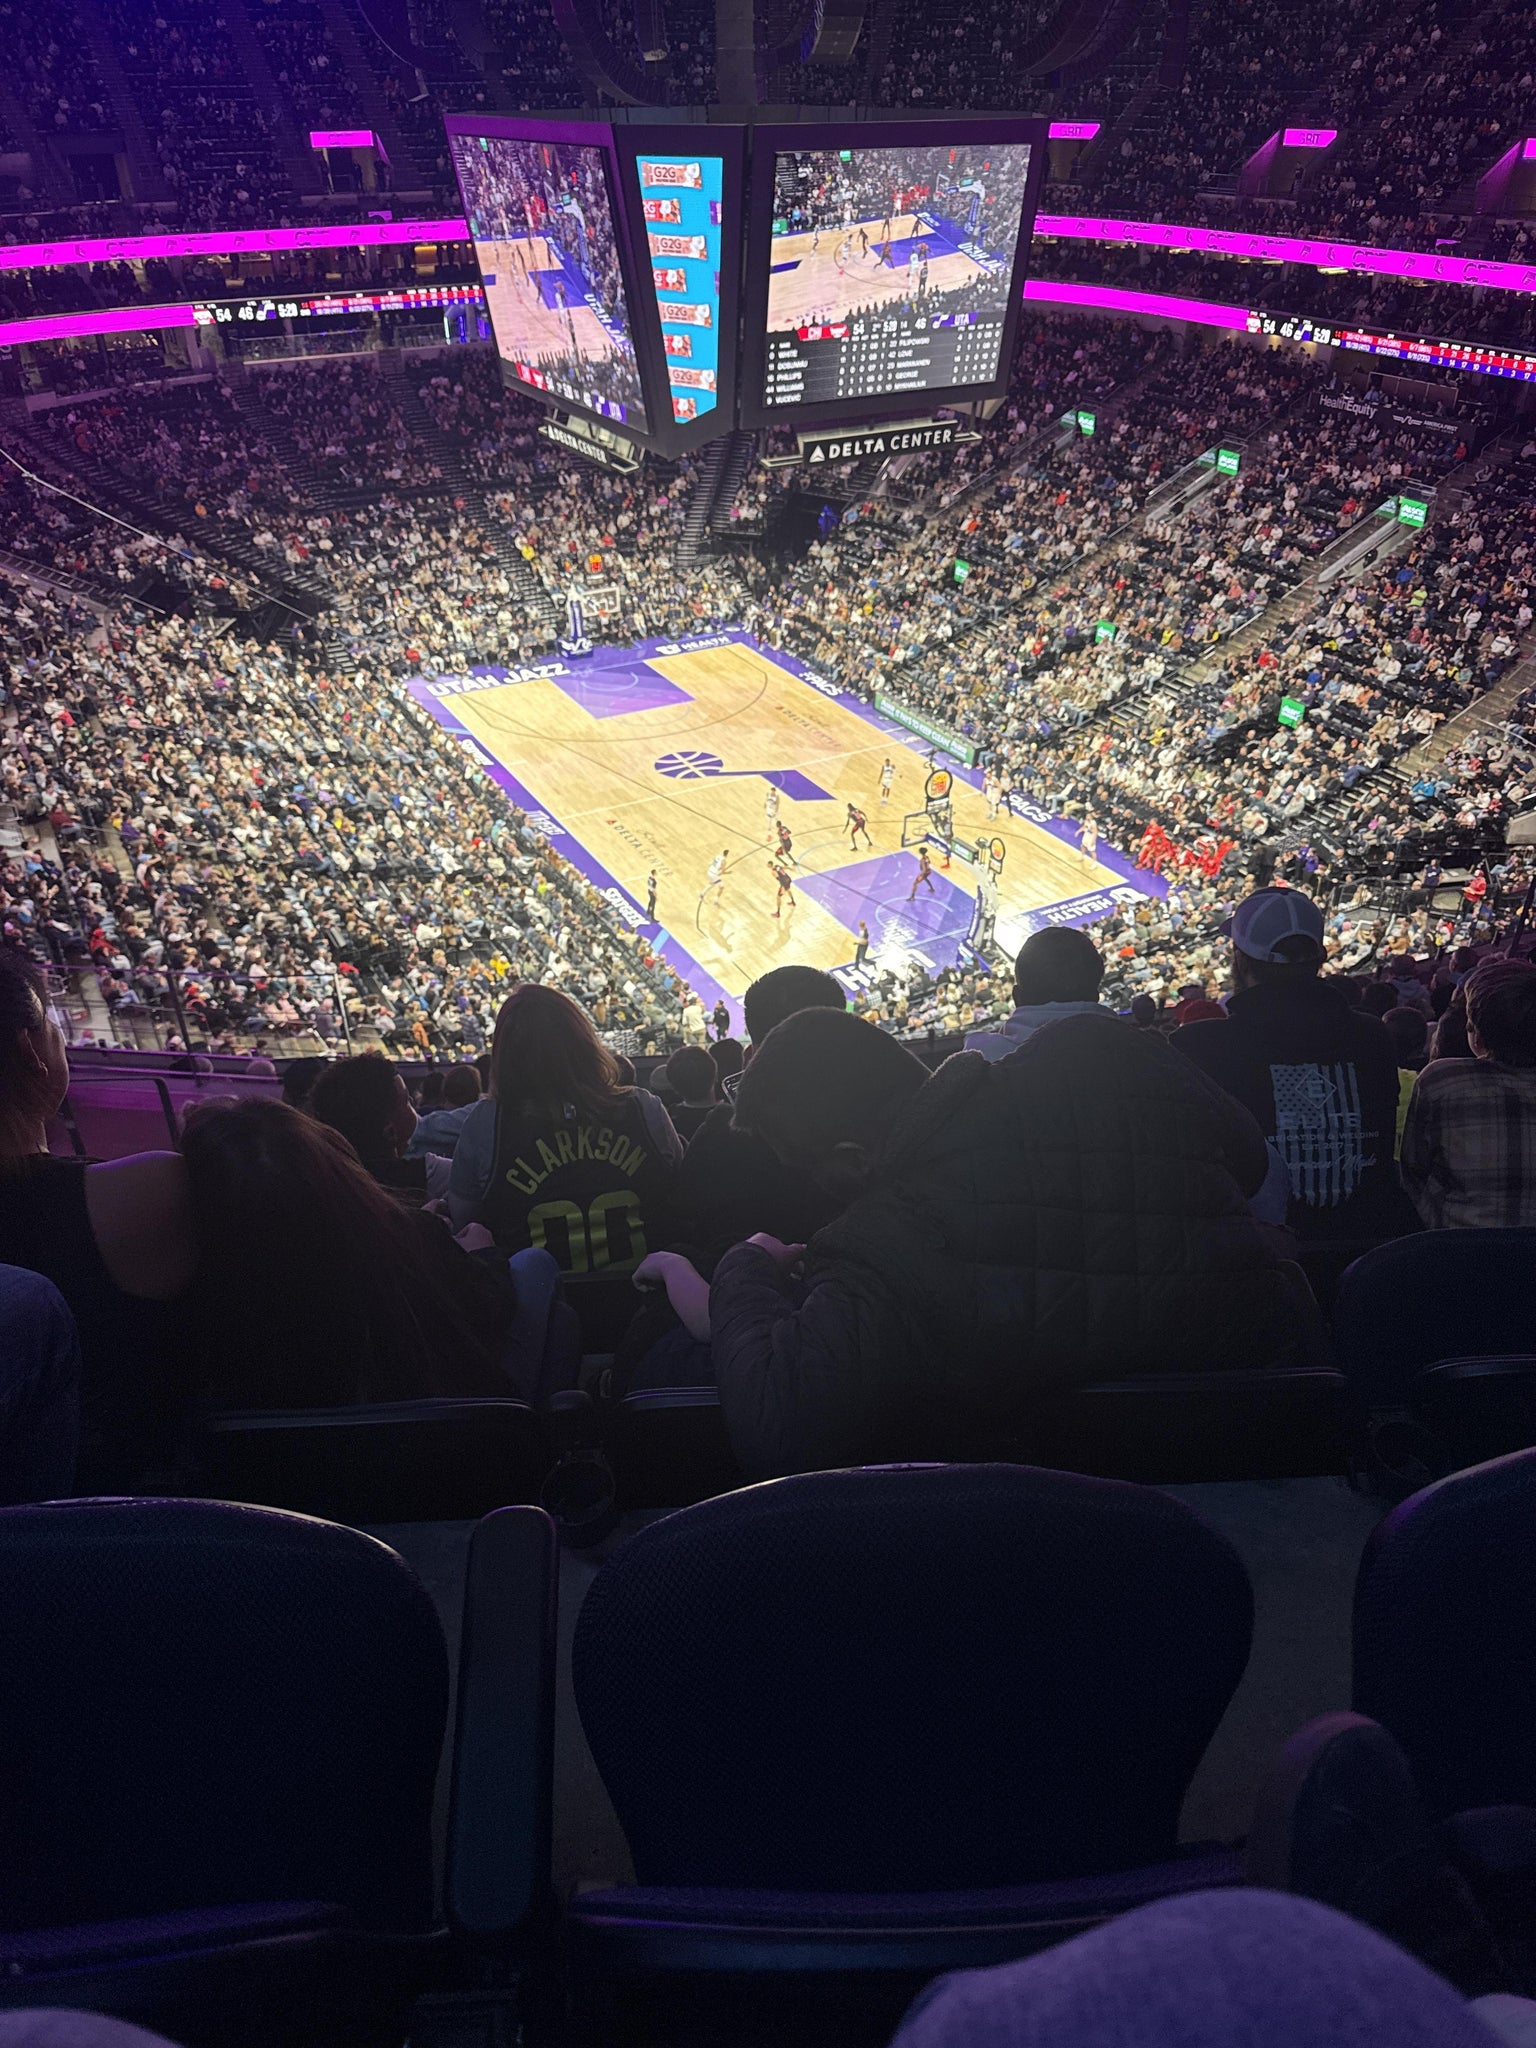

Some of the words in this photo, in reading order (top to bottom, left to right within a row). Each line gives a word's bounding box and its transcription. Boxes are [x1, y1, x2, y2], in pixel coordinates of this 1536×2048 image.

[653, 166, 676, 178] G2G
[660, 237, 682, 250] G2G
[216, 308, 232, 322] 54
[238, 307, 254, 320] 46
[666, 305, 687, 317] G2G
[853, 323, 865, 335] 54
[915, 317, 927, 330] 46
[954, 313, 970, 326] UTA
[1263, 320, 1276, 334] 54
[1280, 322, 1294, 337] 46
[673, 370, 693, 381] G2G
[1320, 395, 1378, 419] HealthEquity
[553, 427, 578, 450] DELTA
[578, 440, 607, 464] CENTER
[828, 438, 885, 460] DELTA
[890, 429, 952, 450] CENTER
[426, 674, 501, 697] UTAH
[503, 662, 571, 684] JAZZ
[614, 824, 642, 849] DELTA
[605, 887, 650, 928] SEATGEEK
[1278, 1112, 1361, 1129] ELITE
[506, 1126, 647, 1195] CLARKSON
[528, 1190, 647, 1273] 00
